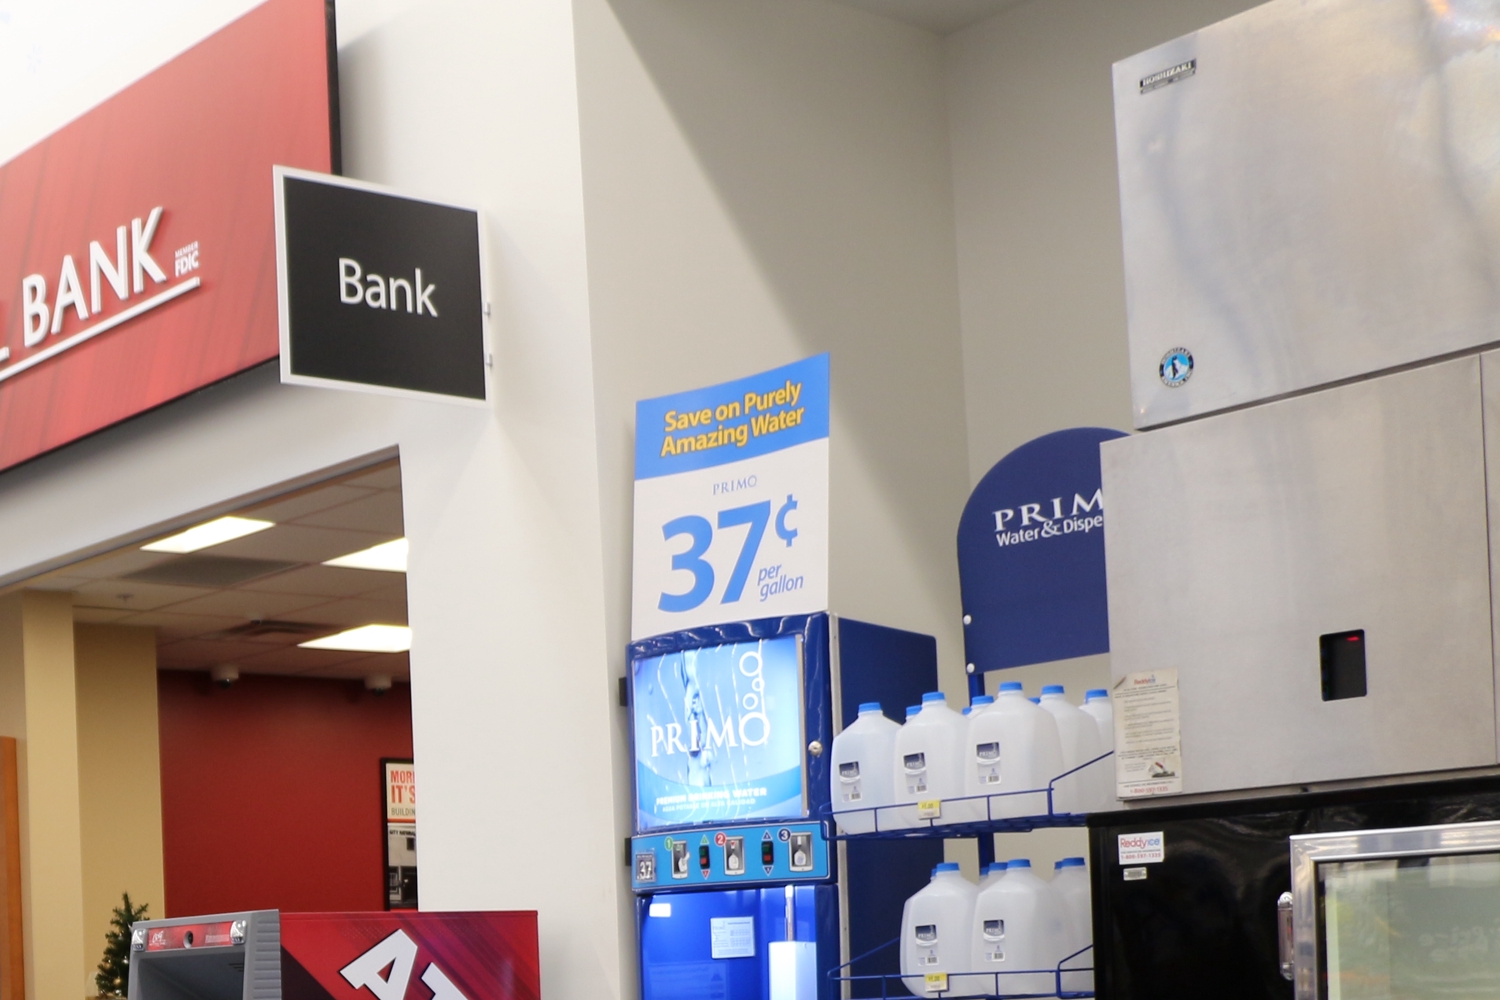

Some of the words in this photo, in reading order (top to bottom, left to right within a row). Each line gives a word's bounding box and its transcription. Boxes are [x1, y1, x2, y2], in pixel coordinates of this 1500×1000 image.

[22, 206, 167, 349] BANK
[174, 251, 200, 278] FDIC
[338, 257, 439, 319] Bank
[664, 410, 712, 432] Save
[714, 400, 741, 422] on
[743, 380, 802, 414] Purely
[660, 422, 749, 458] Amazing
[750, 406, 805, 438] Water
[712, 474, 758, 496] PRIMO
[995, 527, 1040, 547] Water
[757, 563, 782, 586] per
[759, 574, 805, 603] gallon
[650, 711, 770, 757] PRIMO
[732, 787, 767, 798] WATER
[717, 833, 725, 845] 2
[780, 830, 789, 841] 3
